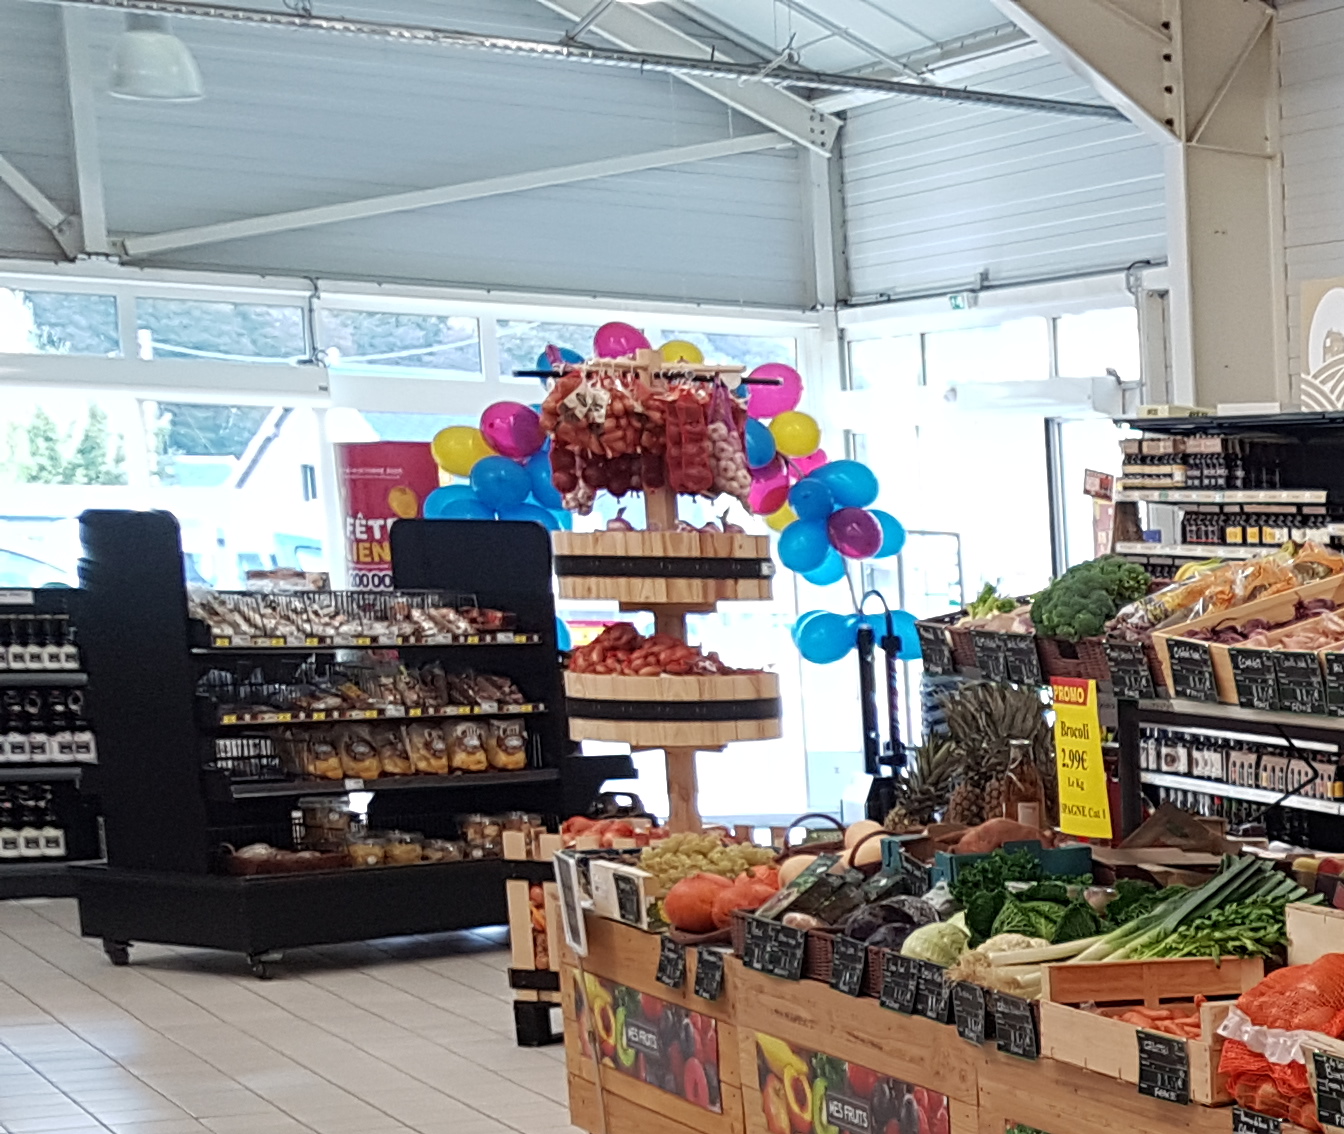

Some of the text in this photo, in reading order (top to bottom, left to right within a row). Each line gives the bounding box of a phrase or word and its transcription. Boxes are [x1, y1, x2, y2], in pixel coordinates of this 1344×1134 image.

[1053, 686, 1085, 703] PROMO
[1060, 721, 1090, 740] Brocoli
[1068, 777, 1076, 787] Le
[639, 1030, 658, 1048] FRUITS
[829, 1101, 869, 1128] MES FRUITS
